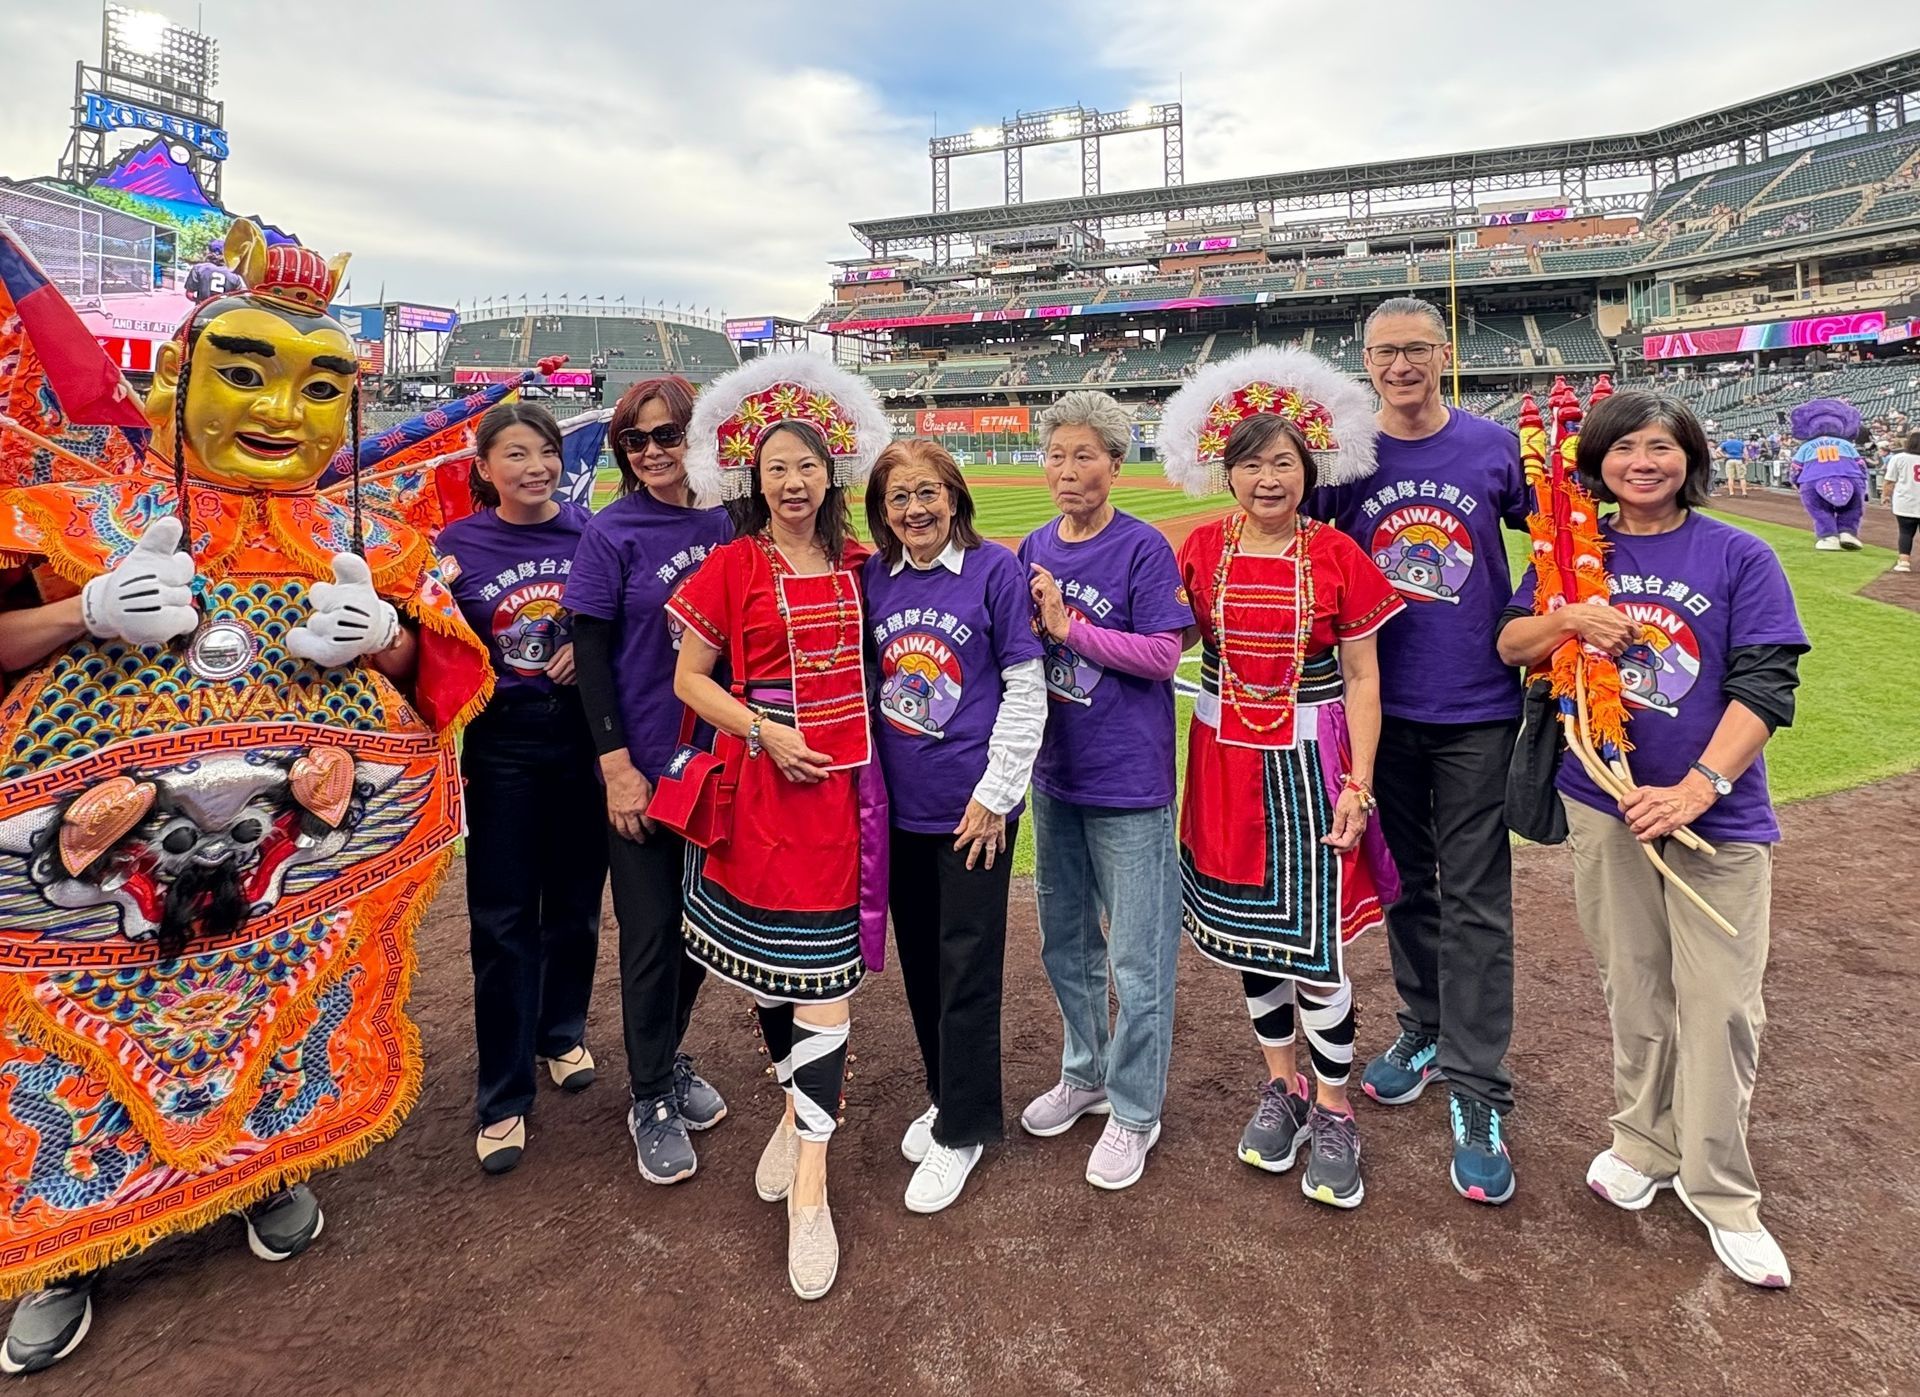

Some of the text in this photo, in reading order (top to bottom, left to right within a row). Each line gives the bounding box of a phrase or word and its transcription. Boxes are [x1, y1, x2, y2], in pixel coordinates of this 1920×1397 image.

[81, 92, 230, 161] ROCKIES
[210, 271, 226, 293] 2
[113, 319, 134, 331] AND
[134, 321, 152, 332] GET
[899, 413, 908, 423] of
[980, 415, 1021, 427] STIHL
[1817, 446, 1840, 463] 00
[1361, 479, 1478, 518] 洛磯隊台灣日
[1380, 508, 1459, 535] TAIWAN
[498, 584, 564, 614] TAIWA
[873, 607, 973, 646] 洛磯隊台灣日
[885, 636, 952, 665] TAIWAN
[110, 682, 323, 731] TAIWAN
